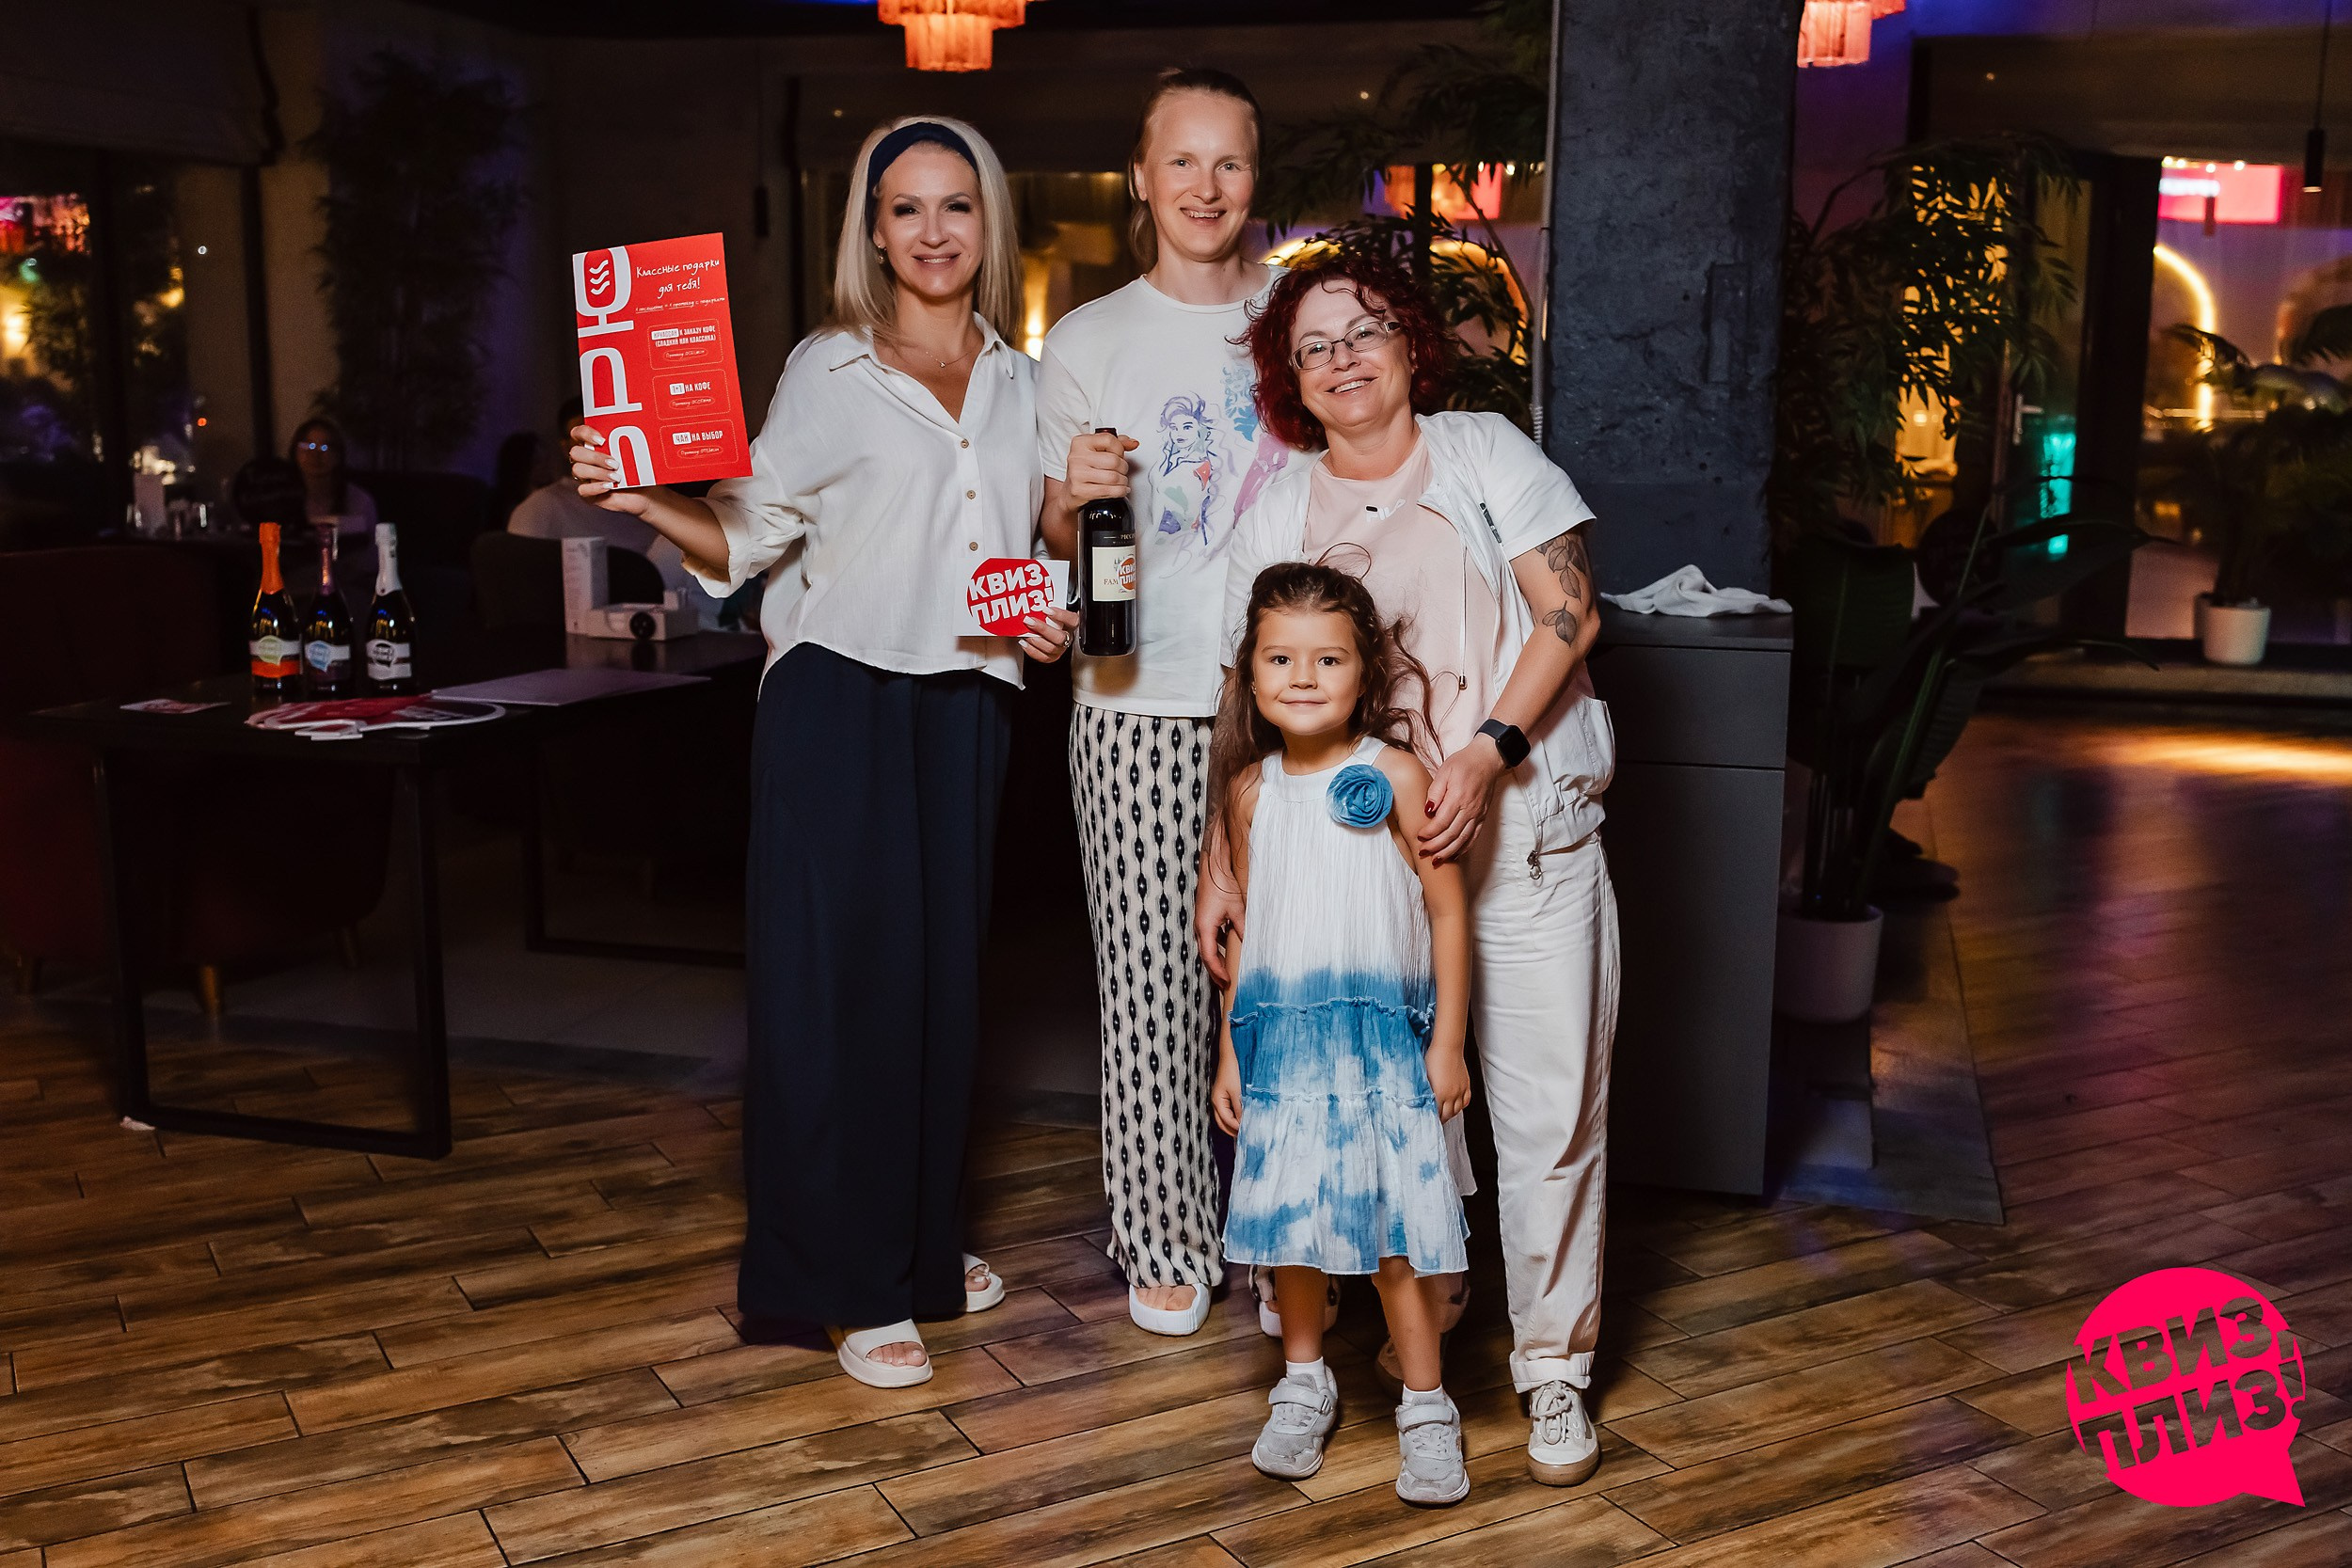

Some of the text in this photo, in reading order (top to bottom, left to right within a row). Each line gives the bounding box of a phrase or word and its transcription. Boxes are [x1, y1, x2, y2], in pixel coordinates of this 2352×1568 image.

[636, 259, 720, 278] Классные подарки
[657, 277, 701, 299] для тебя!
[702, 325, 716, 334] КОФЕ
[685, 384, 694, 393] НА
[694, 381, 711, 391] КОФЕ
[675, 431, 723, 443] ЧАЙ НА ВЫБОР
[970, 588, 1054, 625] ПЛИЗ!
